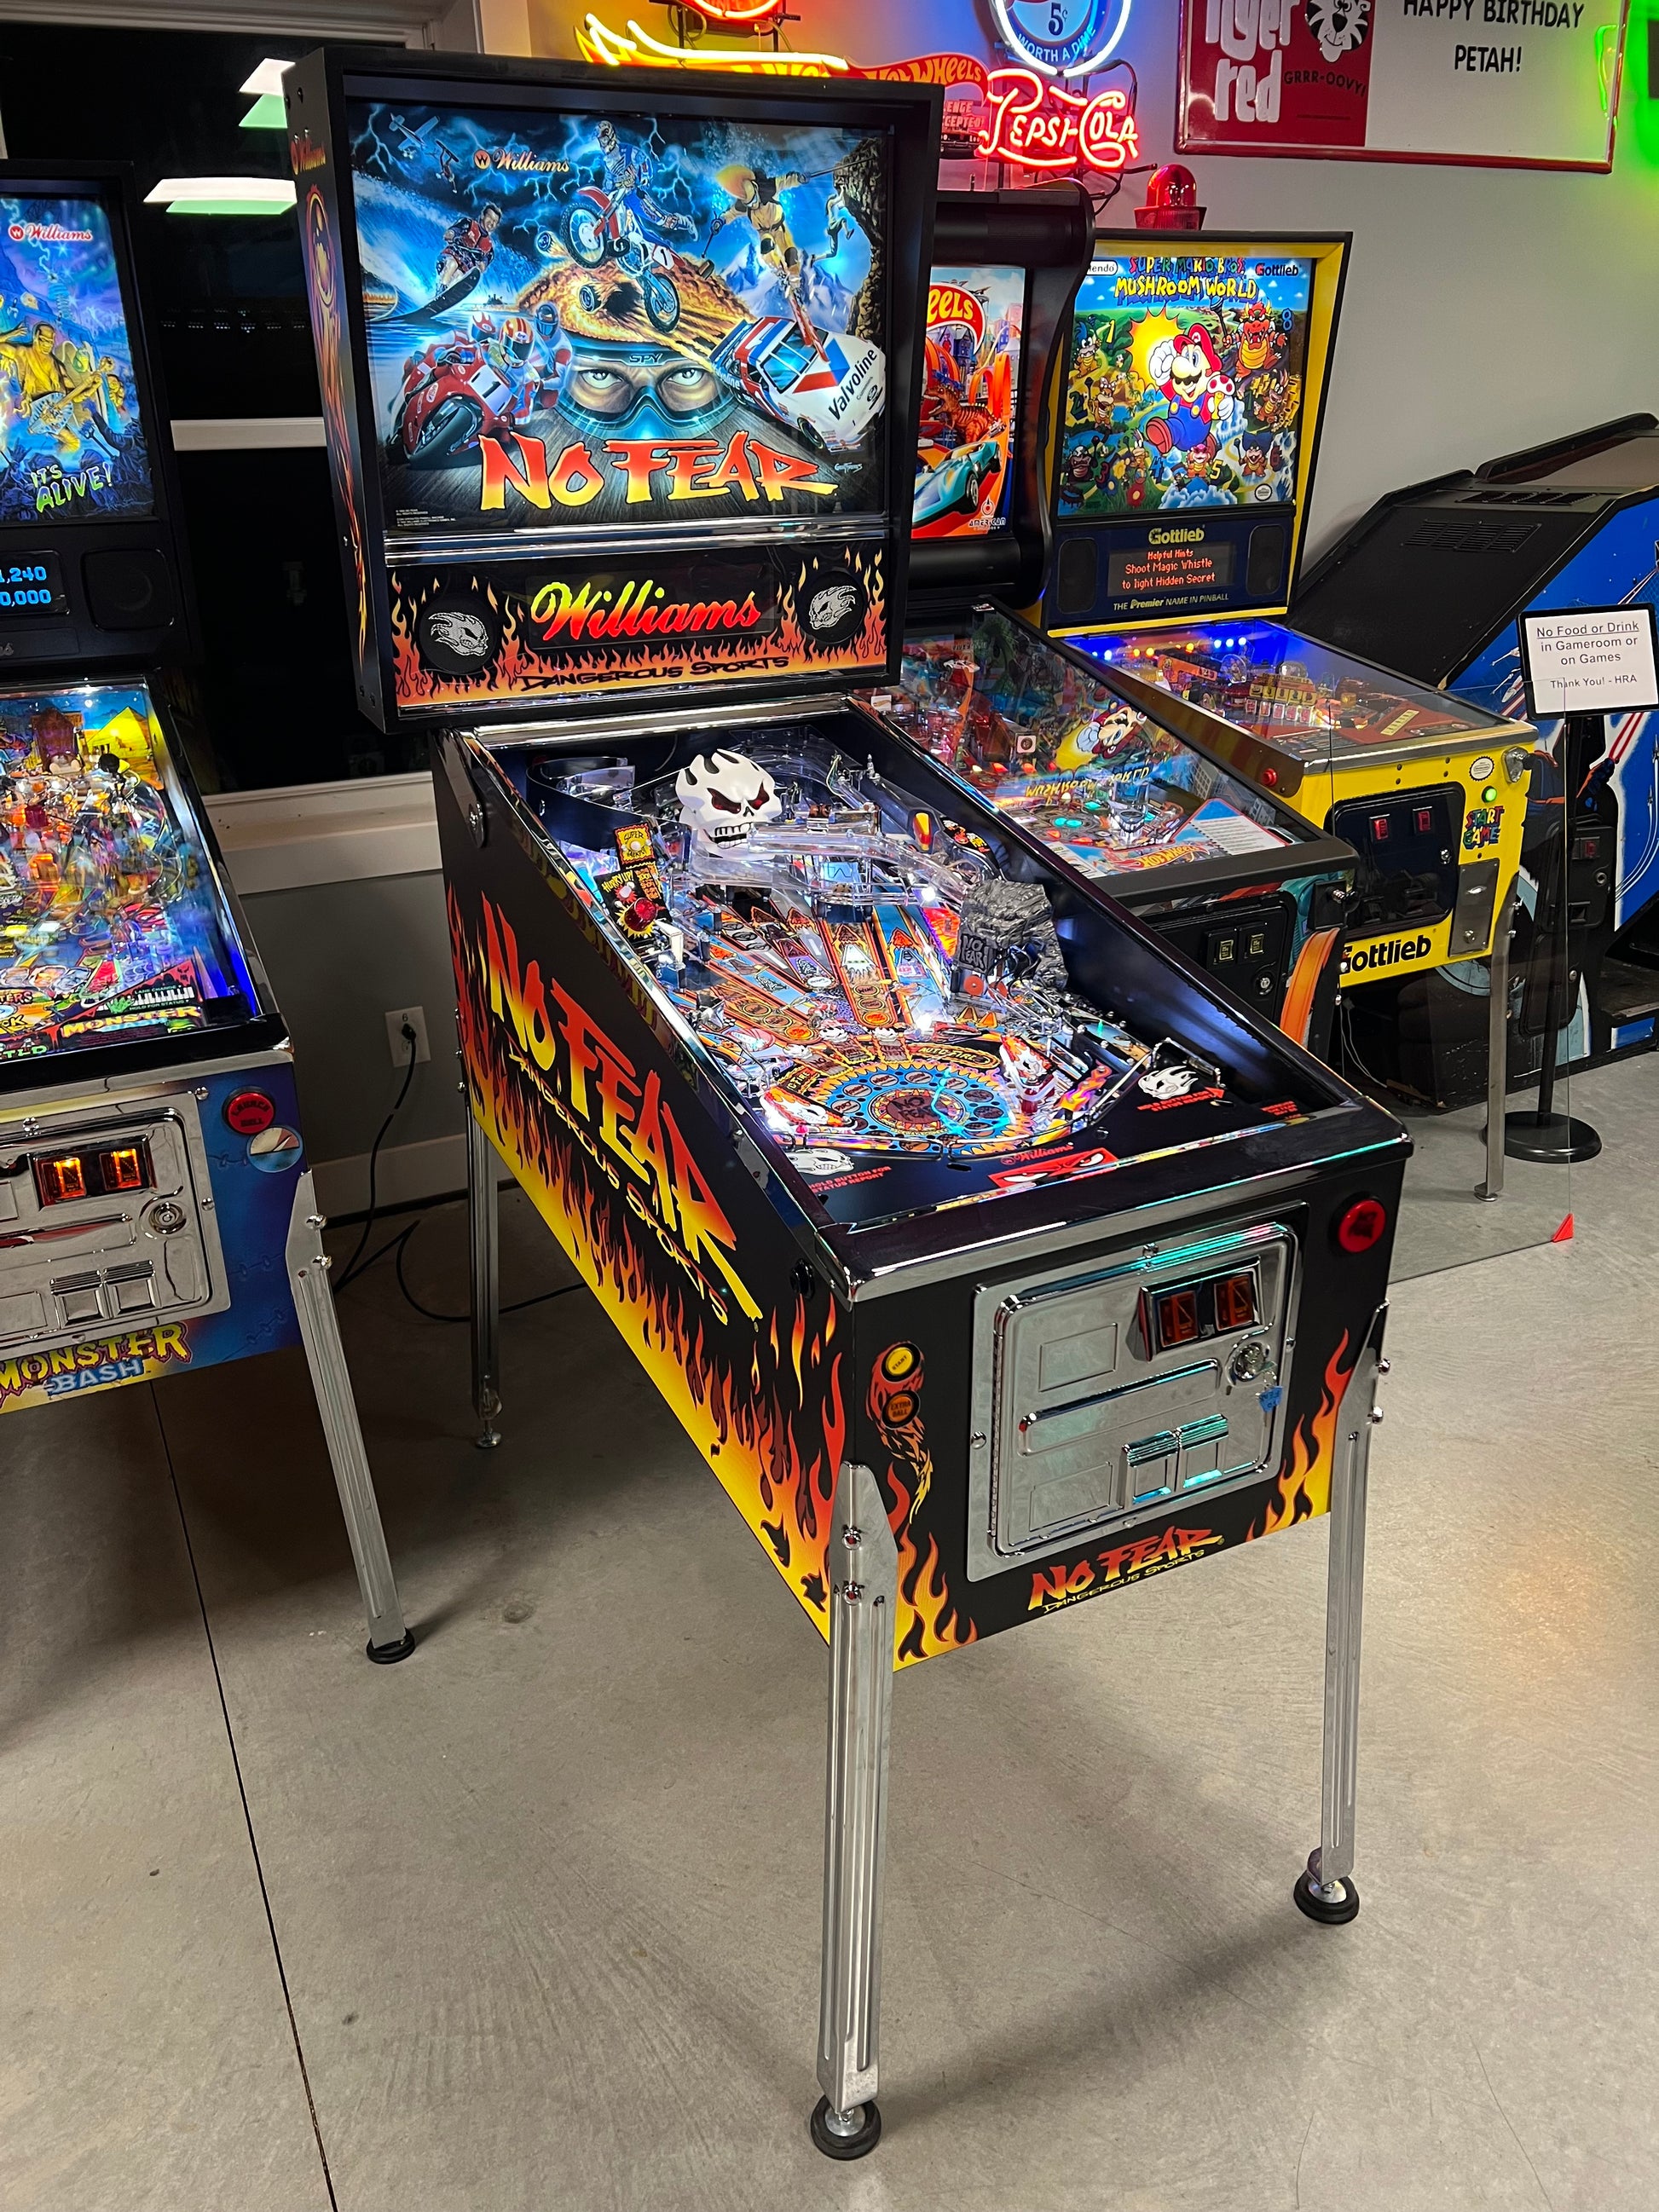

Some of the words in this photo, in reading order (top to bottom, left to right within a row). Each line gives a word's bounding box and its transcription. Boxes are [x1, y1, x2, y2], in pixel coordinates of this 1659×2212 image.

[1403, 0, 1473, 20] HAPPY
[1483, 0, 1585, 28] BIRTHDAY
[1017, 33, 1059, 62] WORTH
[1062, 48, 1071, 61] A
[1454, 44, 1523, 73] PETAH!
[1214, 49, 1283, 123] red
[492, 147, 569, 173] Williams
[25, 222, 94, 242] Williams
[1255, 263, 1299, 277] Gottlieb
[1114, 274, 1201, 298] MUSHROOM
[1204, 277, 1258, 299] WORLD
[629, 353, 663, 363] SPY
[828, 349, 878, 421] Valvoline
[31, 465, 64, 488] IT'S
[478, 430, 605, 511] NO
[602, 430, 839, 505] FEAR
[35, 462, 114, 513] ALIVE!
[1148, 526, 1205, 546] Gottlieb
[1125, 563, 1151, 575] Shoot
[1153, 562, 1179, 575] Magic
[1181, 557, 1213, 570] Whistle
[1147, 550, 1173, 562] Helpful
[1175, 548, 1194, 559] Hints
[1122, 580, 1131, 590] to
[1134, 577, 1153, 591] light
[1156, 575, 1184, 587] Hidden
[1186, 572, 1216, 585] Secret
[530, 579, 762, 642] Williams
[1113, 602, 1129, 611] THE
[1130, 598, 1165, 610] Premier
[1165, 596, 1189, 606] NAME
[1189, 595, 1199, 604] IN
[1199, 592, 1230, 602] PINBALL
[1536, 627, 1553, 638] No
[1558, 624, 1587, 636] Food
[1591, 624, 1604, 633] or
[1607, 621, 1639, 632] Drink
[1540, 642, 1552, 652] in
[1556, 638, 1621, 651] Gameroom
[1626, 637, 1638, 645] or
[1560, 656, 1575, 666] on
[1580, 652, 1621, 664] Games
[516, 665, 684, 692] DANGEROUS
[690, 656, 789, 675] SPORTS
[1550, 679, 1581, 690] Thank
[1582, 677, 1605, 686] You!
[1615, 674, 1638, 684] HRA
[1465, 806, 1505, 829] START
[1463, 825, 1500, 850] GAME
[483, 890, 556, 1071] NO
[61, 1005, 201, 1038] MONSTER
[551, 977, 764, 1323] FEAR
[1014, 1144, 1074, 1163] Williams
[834, 1169, 872, 1183] BUTTON
[871, 1164, 893, 1174] FOR
[847, 1171, 885, 1186] REPORT
[0, 1323, 189, 1393] MONSTER
[891, 1354, 908, 1371] START
[55, 1356, 142, 1395] BASH
[1027, 1559, 1095, 1611] NO
[1096, 1525, 1223, 1583] FEAR
[1042, 1574, 1140, 1614] DANGEROUS
[1143, 1549, 1205, 1577] SPORTS
